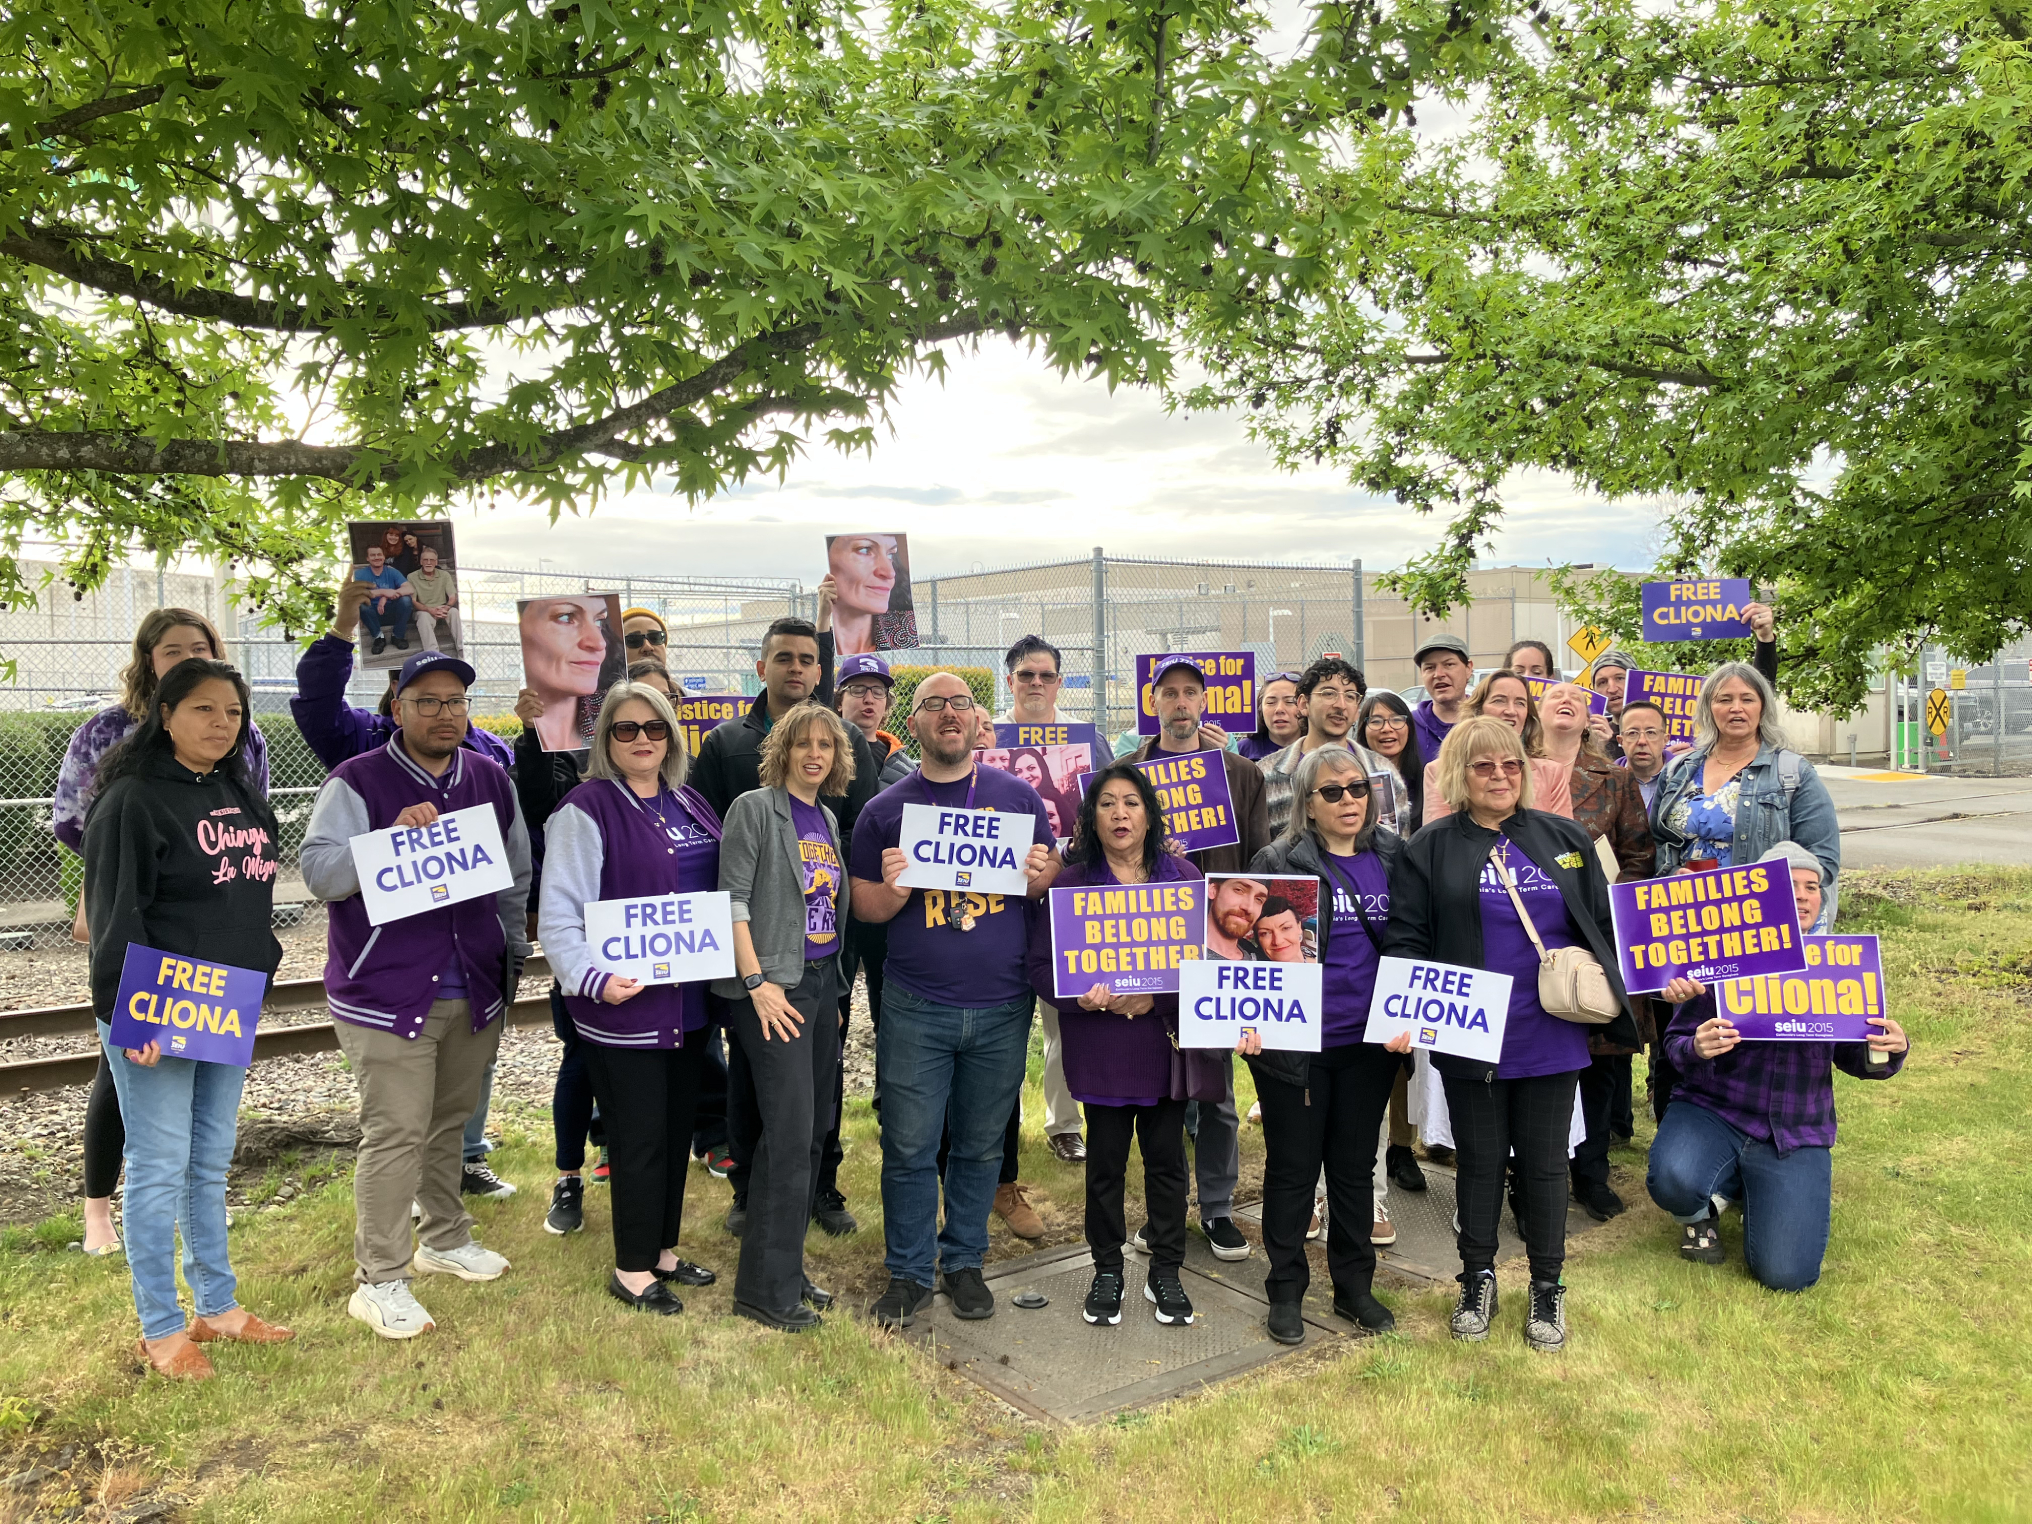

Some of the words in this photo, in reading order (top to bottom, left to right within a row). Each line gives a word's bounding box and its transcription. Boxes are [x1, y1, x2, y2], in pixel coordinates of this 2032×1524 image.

[1670, 582, 1721, 601] FREE
[1653, 604, 1741, 625] CLIONA
[1219, 656, 1244, 676] for
[1650, 696, 1698, 717] BELO
[1019, 727, 1068, 745] FREE
[1156, 784, 1203, 811] ONG
[390, 818, 461, 857] FREE
[938, 812, 1001, 840] FREE
[376, 844, 494, 892] CLIONA
[913, 839, 1018, 870] CLIONA
[1073, 886, 1195, 916] FAMILIES
[1635, 868, 1769, 911] FAMILIES
[624, 900, 693, 929] FREE
[1650, 899, 1763, 938] BELONG
[602, 928, 720, 961] CLIONA
[1085, 916, 1187, 944] BELONG
[1064, 944, 1204, 974] TOGETHER
[1630, 924, 1792, 969] TOGETHER!
[1825, 940, 1863, 966] for
[157, 956, 228, 998] FREE
[1115, 975, 1140, 987] seiu
[1141, 977, 1163, 986] 2015
[1218, 966, 1283, 992] FREE
[1408, 965, 1473, 998] FREE
[1687, 965, 1714, 979] seiu
[1715, 963, 1739, 975] 2015
[1724, 972, 1879, 1015] Cliona!
[129, 991, 242, 1038] CLIONA
[1194, 996, 1307, 1024] CLIONA
[1384, 993, 1489, 1033] CLIONA
[1775, 1019, 1806, 1032] seiu
[1808, 1022, 1833, 1032] 2015
